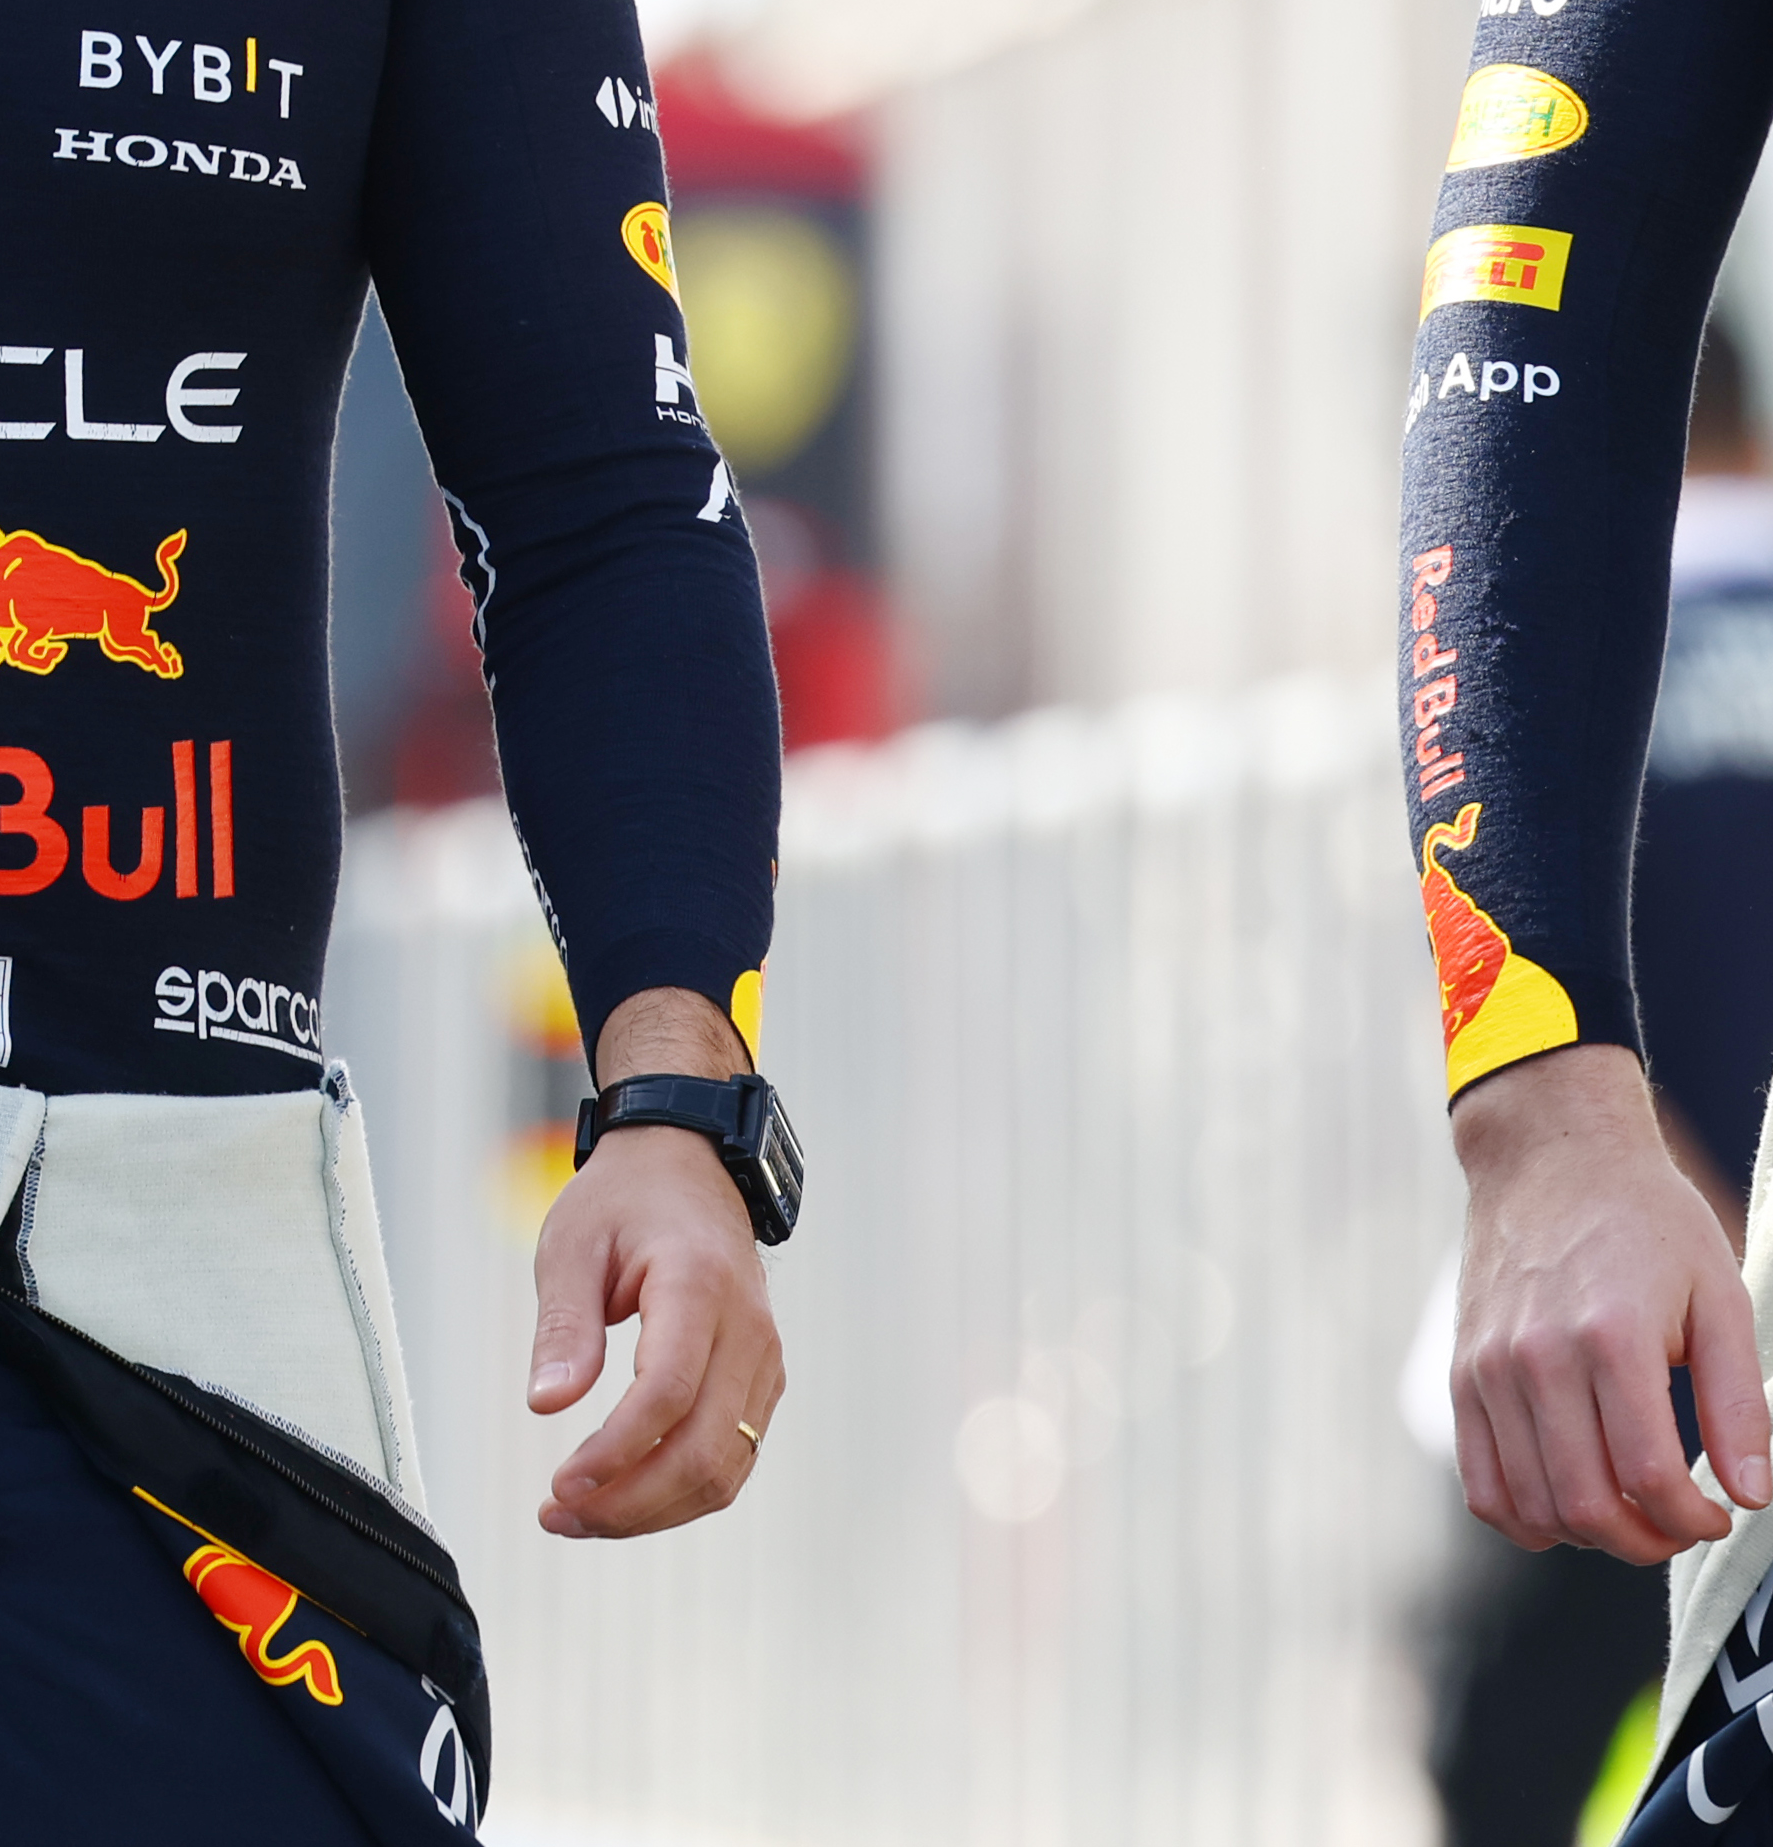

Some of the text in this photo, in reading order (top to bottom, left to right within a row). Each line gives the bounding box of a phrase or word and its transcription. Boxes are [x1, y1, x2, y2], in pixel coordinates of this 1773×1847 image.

[79, 29, 305, 119] BYBIT
[53, 128, 308, 191] HONDA
[1438, 352, 1560, 403] App
[1411, 544, 1466, 805] Red Bull
[154, 966, 321, 1050] sparco
